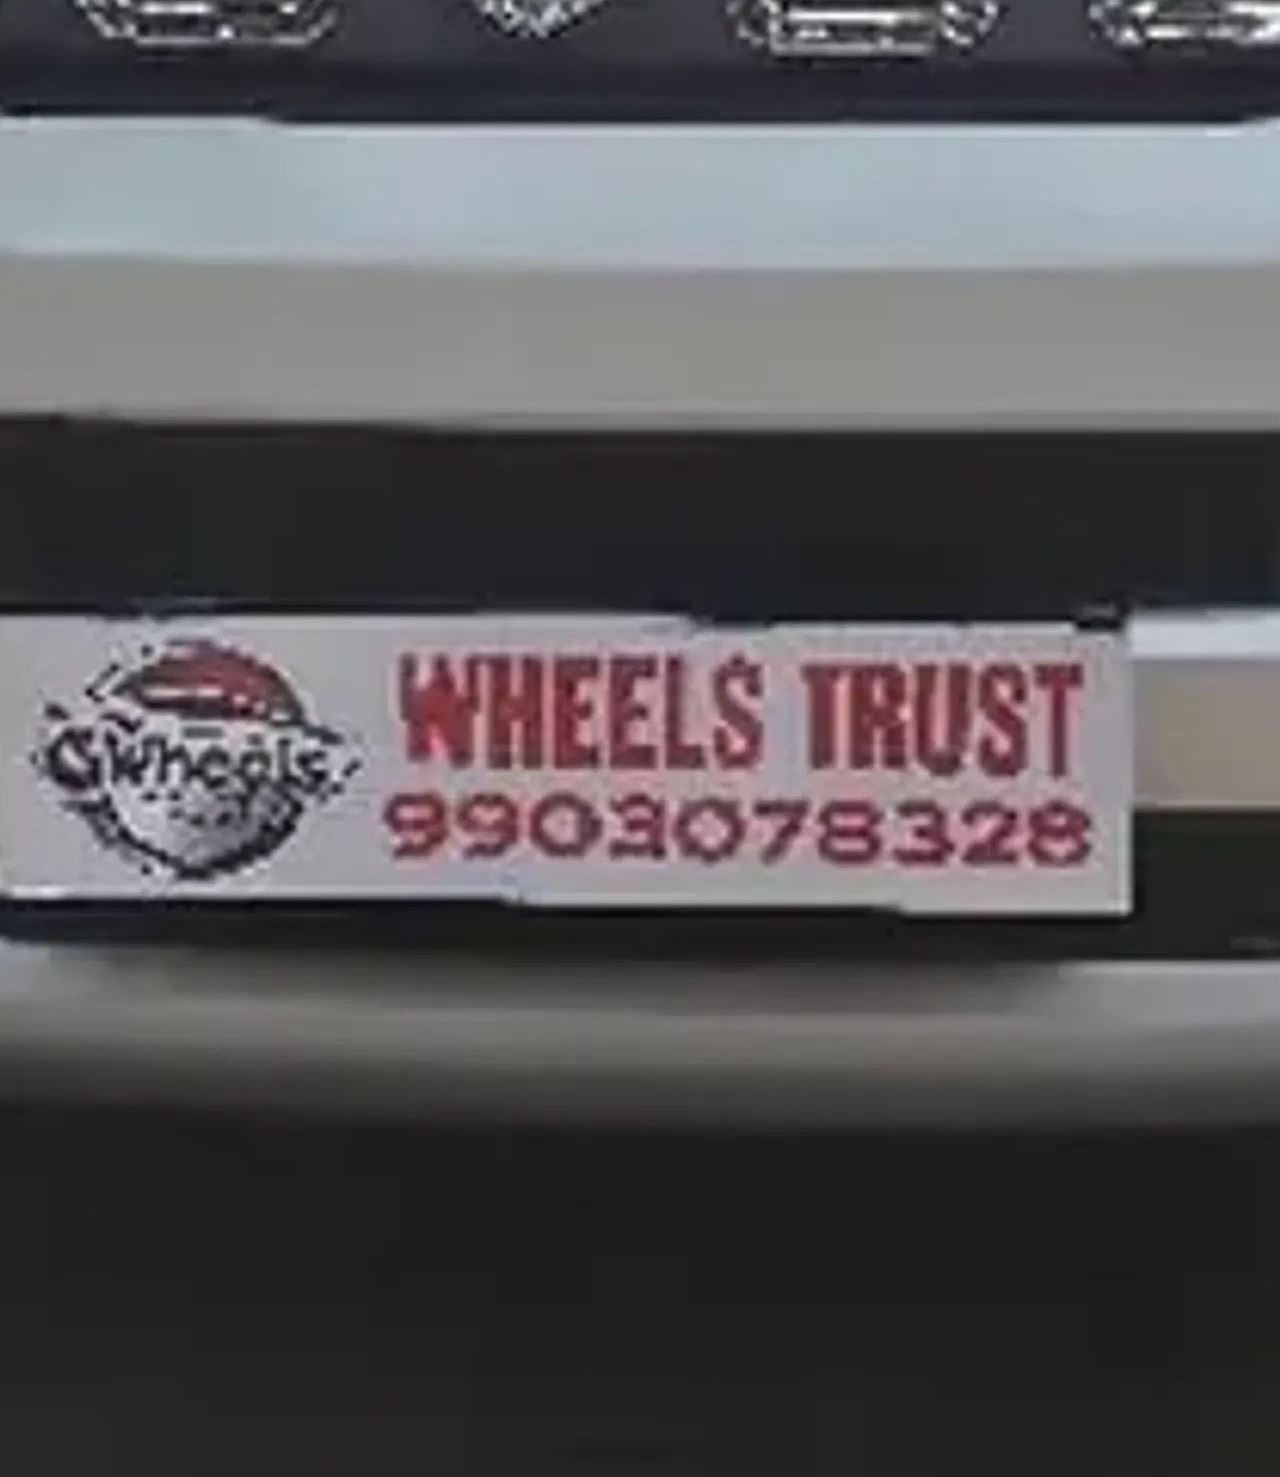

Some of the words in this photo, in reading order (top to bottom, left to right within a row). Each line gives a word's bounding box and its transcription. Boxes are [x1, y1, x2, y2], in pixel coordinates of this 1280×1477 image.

[398, 651, 764, 770] WHEELS
[802, 661, 1086, 777] TRUST
[383, 790, 1093, 869] 9903078328
